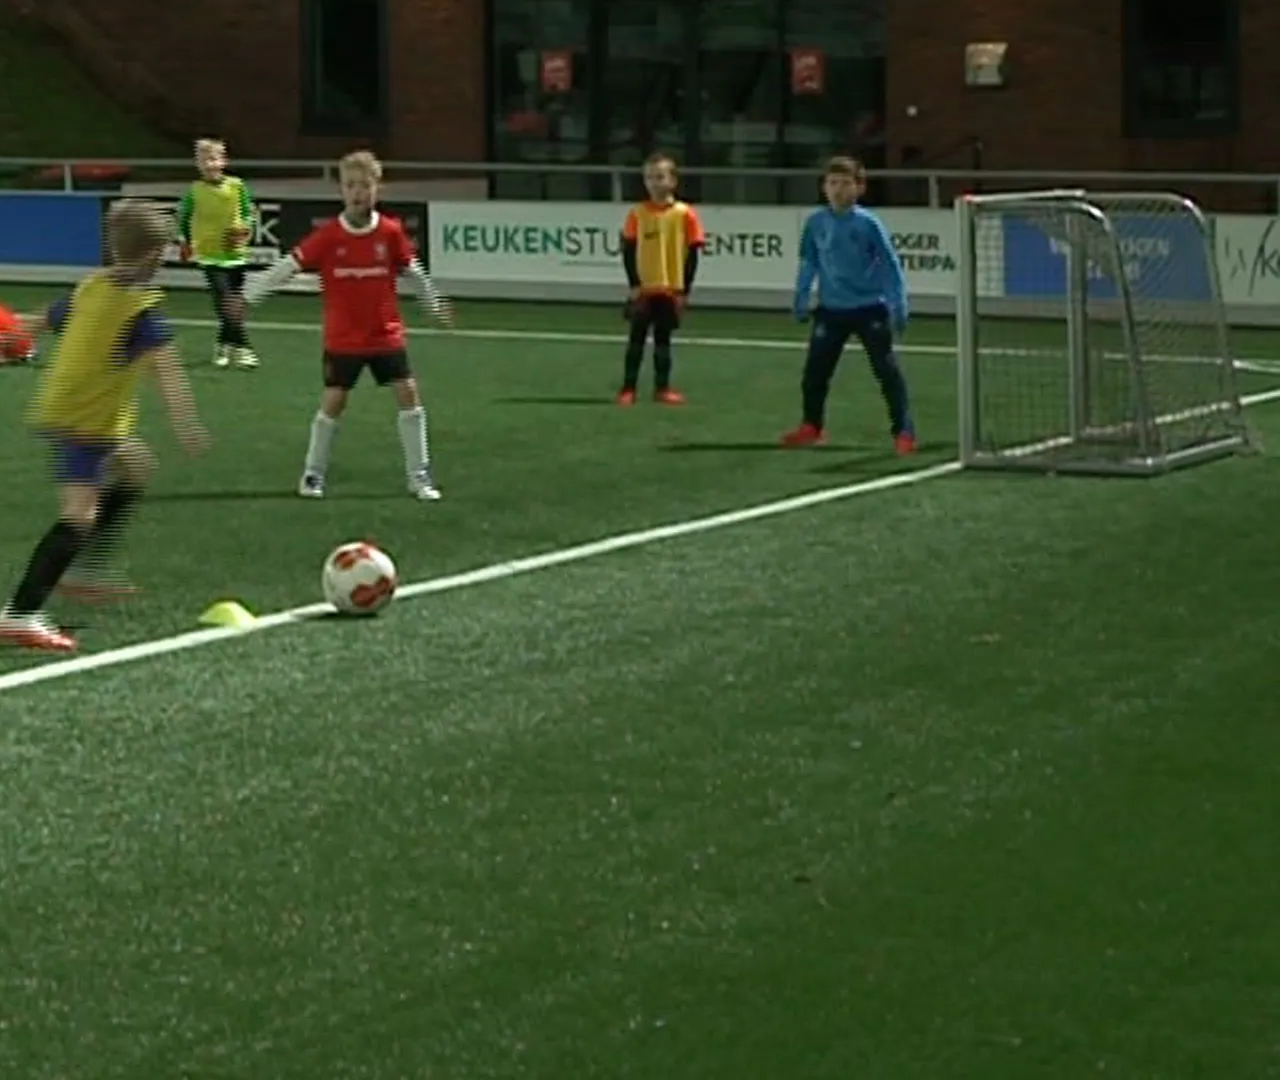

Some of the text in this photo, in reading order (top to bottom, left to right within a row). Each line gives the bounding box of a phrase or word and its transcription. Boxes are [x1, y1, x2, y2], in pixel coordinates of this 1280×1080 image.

[442, 224, 627, 258] KEUKENSTU
[890, 231, 940, 251] OGER
[897, 253, 956, 273] TERPA
